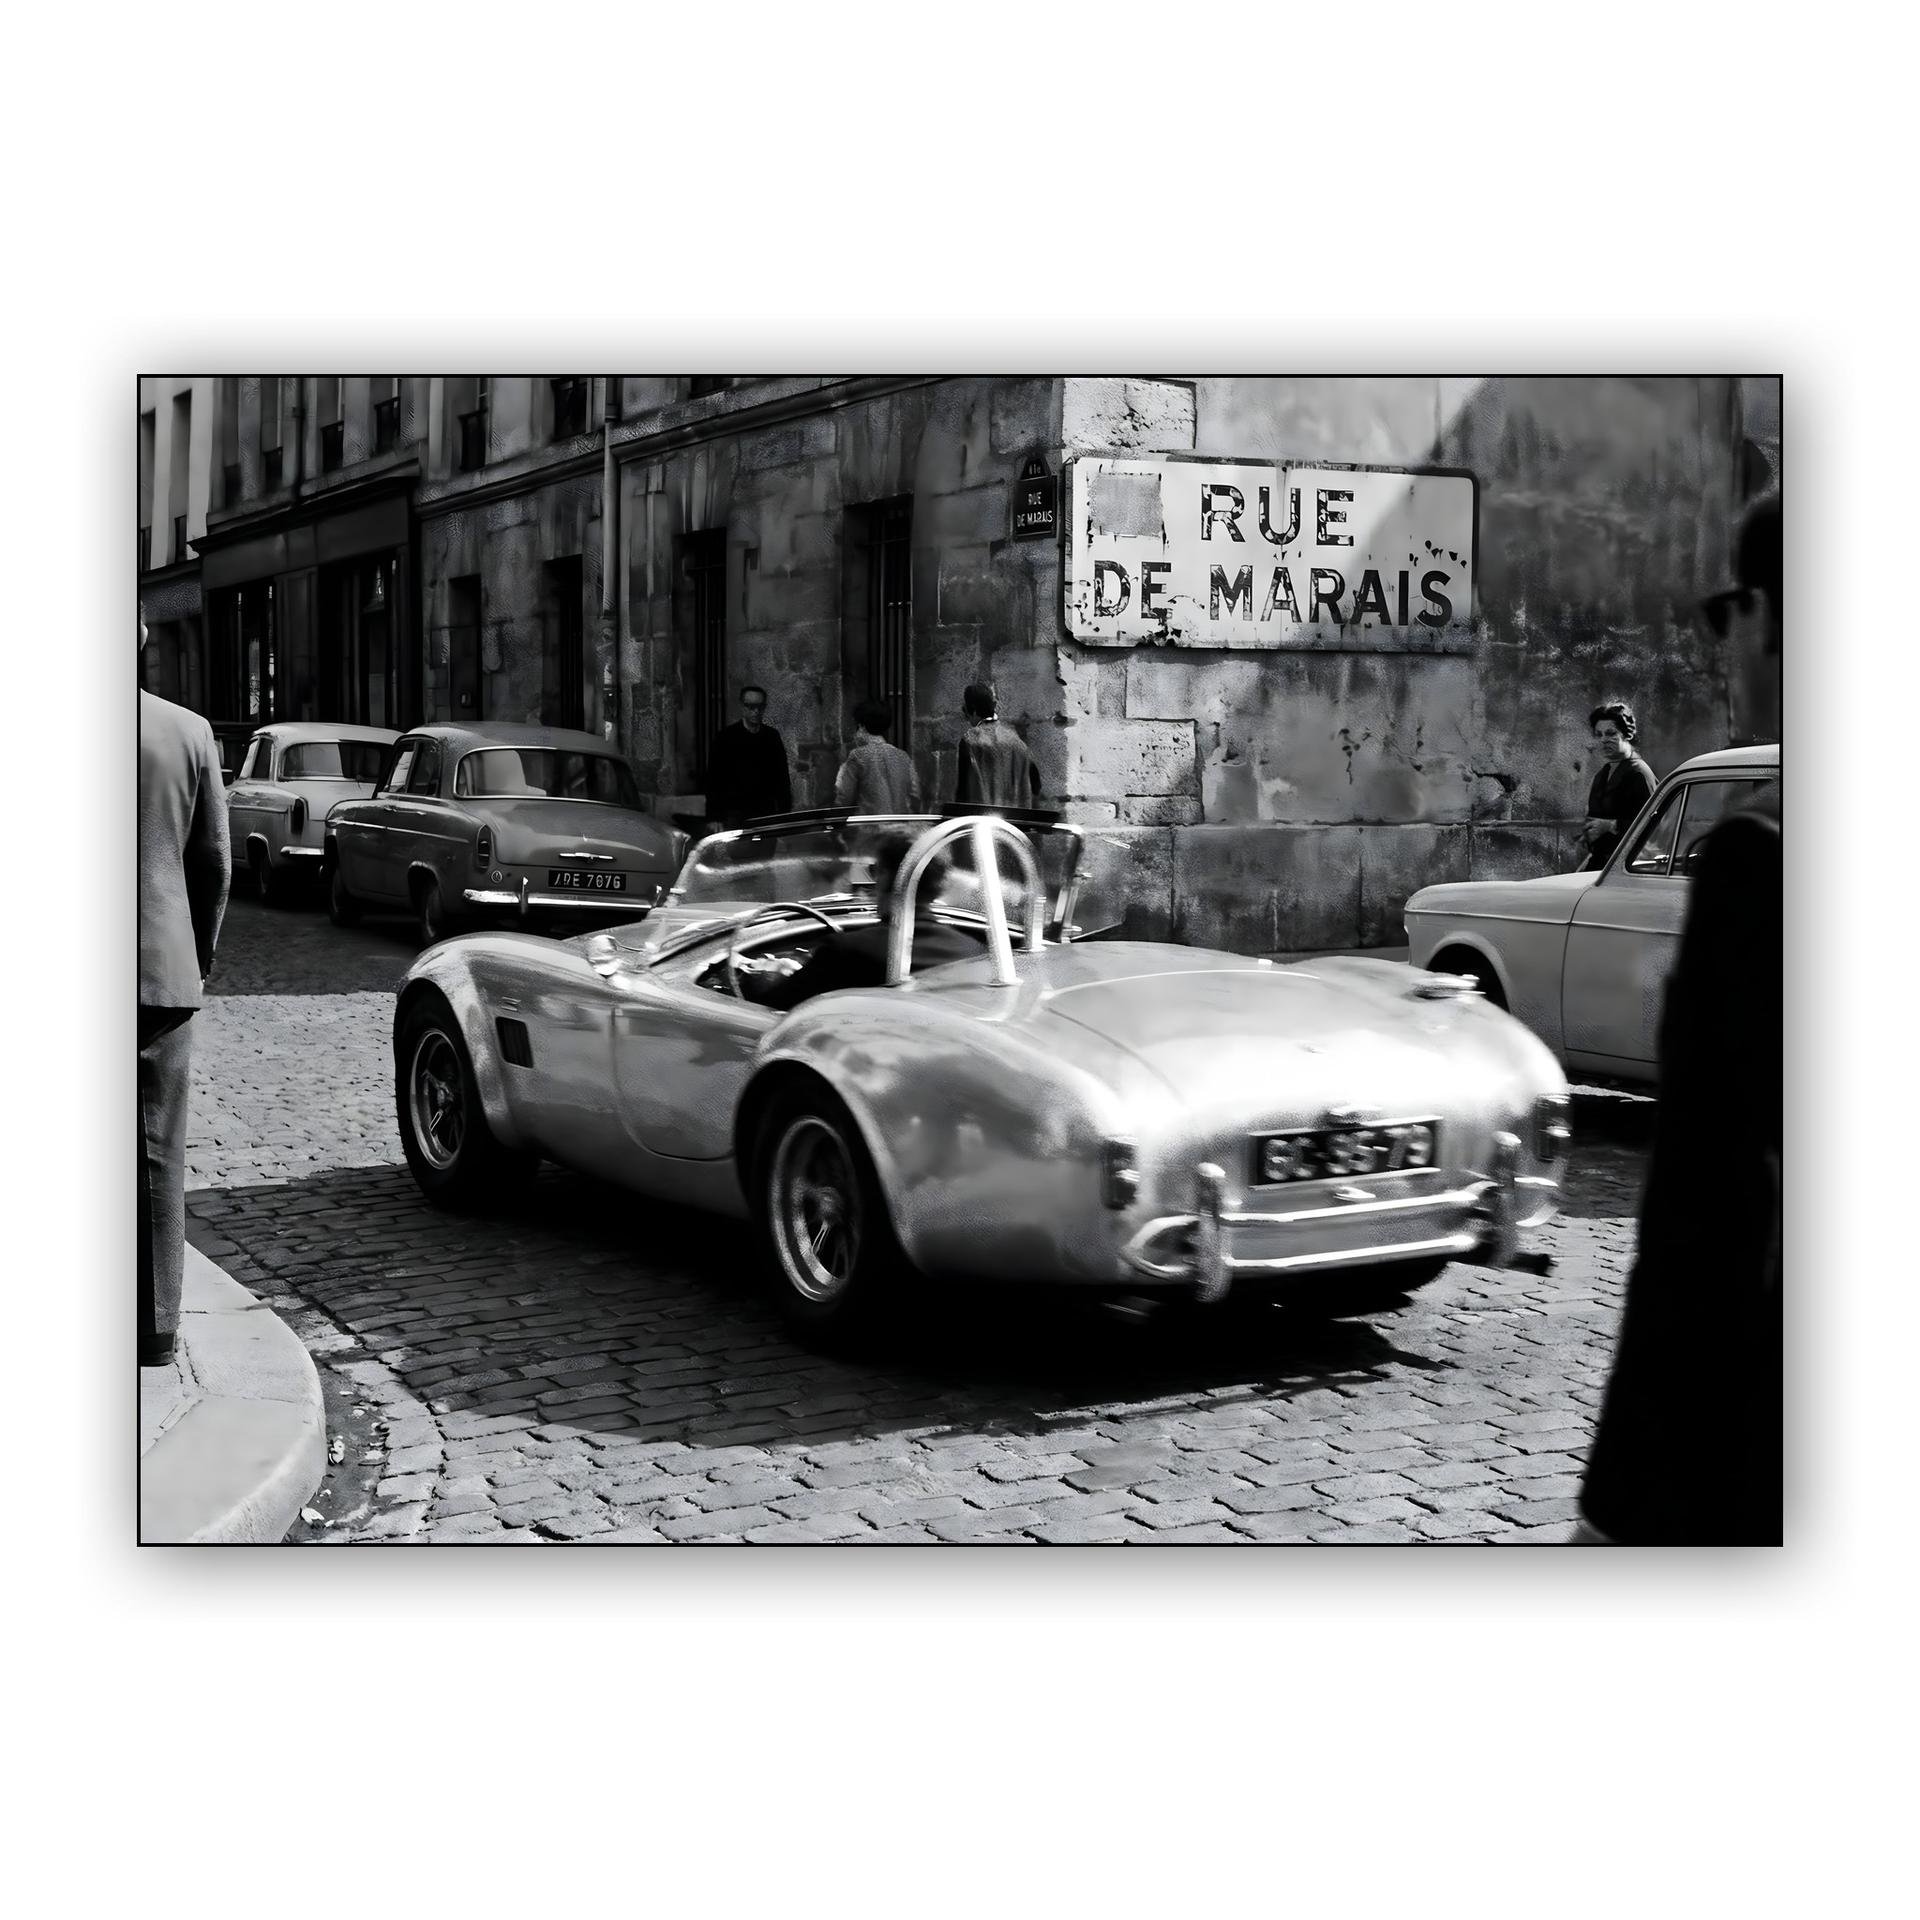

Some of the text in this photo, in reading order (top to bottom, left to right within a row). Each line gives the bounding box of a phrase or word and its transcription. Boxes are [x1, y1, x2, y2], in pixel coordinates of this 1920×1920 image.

[1201, 483, 1354, 546] RUE
[1093, 559, 1453, 627] DE MARAIS
